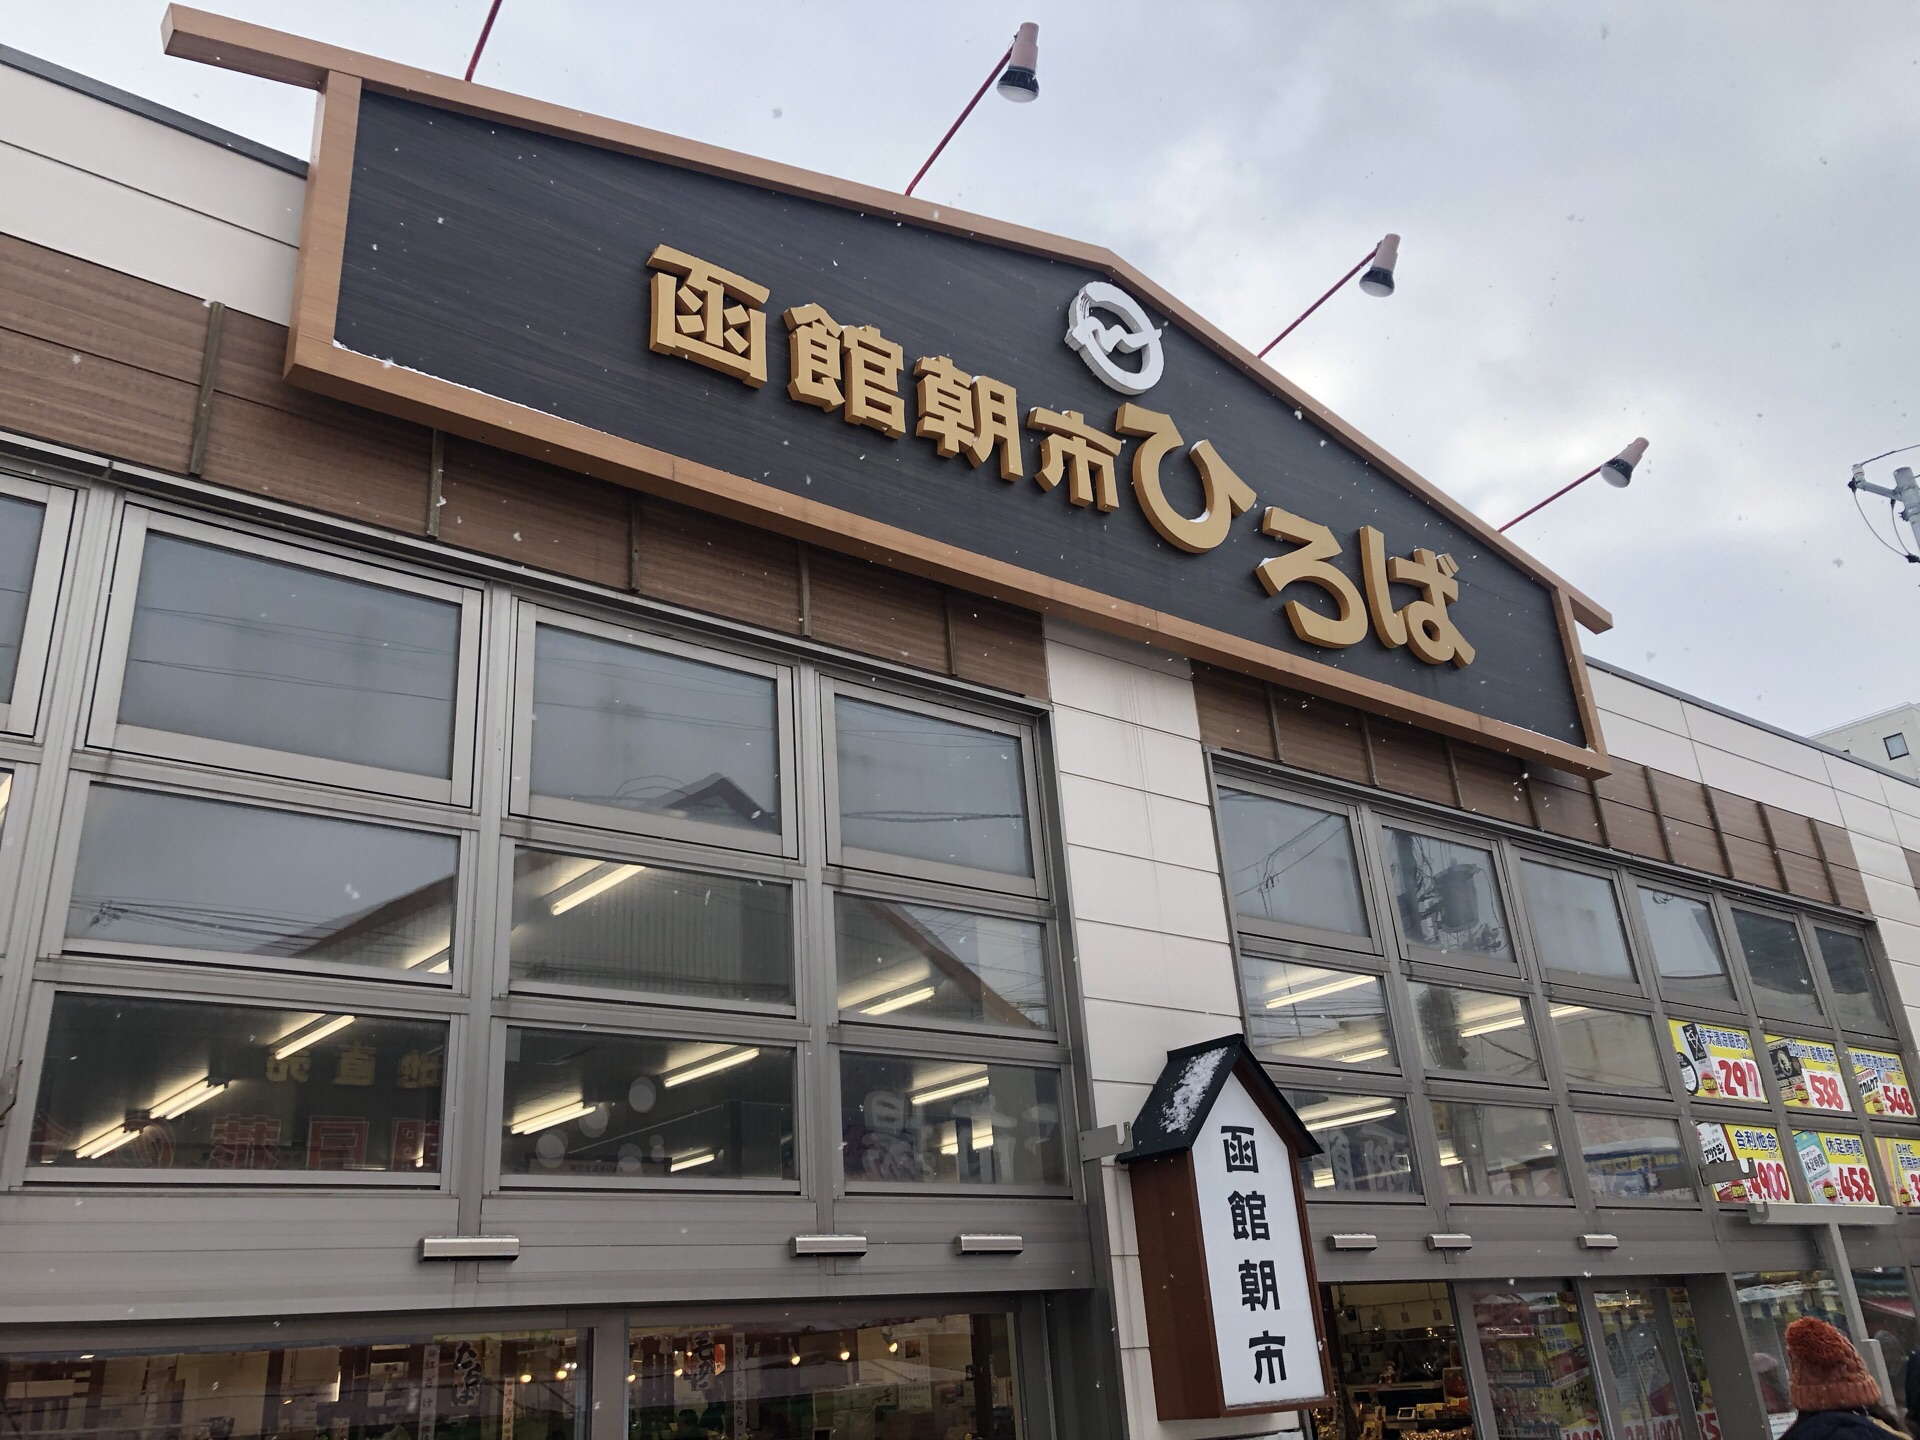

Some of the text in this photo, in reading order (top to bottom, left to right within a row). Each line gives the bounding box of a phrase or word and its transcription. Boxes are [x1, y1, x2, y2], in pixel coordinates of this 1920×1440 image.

[647, 244, 1477, 668] 函館朝市ひろば
[1734, 1129, 1778, 1151] 合利他命
[1825, 1137, 1864, 1156] 休足時間
[1895, 1143, 1914, 1155] DHC
[1839, 1166, 1875, 1203] 458
[1221, 1125, 1288, 1385] 函館朝市
